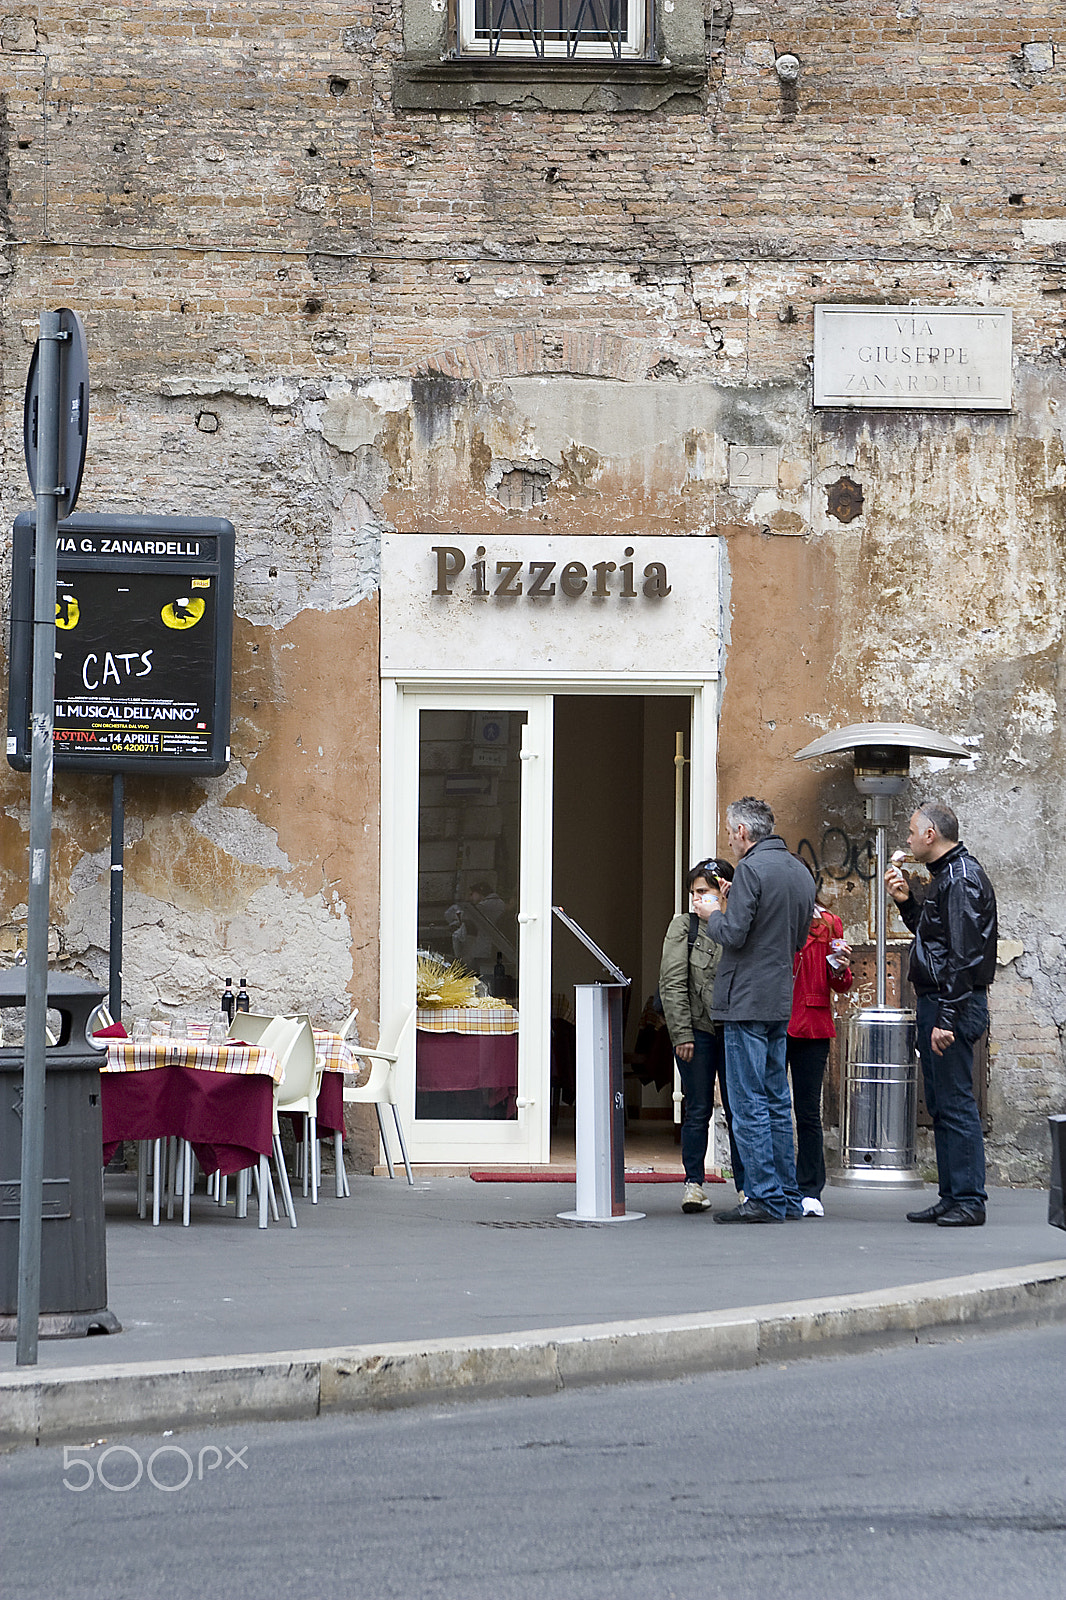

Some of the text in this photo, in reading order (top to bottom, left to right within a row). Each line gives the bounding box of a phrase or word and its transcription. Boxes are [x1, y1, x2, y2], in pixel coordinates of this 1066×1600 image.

[894, 318, 933, 336] VIA
[858, 346, 969, 364] GIUSEPPE
[844, 374, 983, 392] ZANARDELLI
[735, 451, 767, 478] 21
[80, 539, 97, 552] G.
[100, 539, 200, 556] ZANARDELLI
[431, 545, 672, 598] Pizzeria
[82, 649, 154, 690] CATS
[55, 704, 67, 718] IL
[67, 705, 122, 720] MUSICAL
[107, 733, 122, 743] 14
[122, 733, 160, 745] APRILE
[111, 743, 123, 752] 06
[123, 744, 159, 752] 4200711
